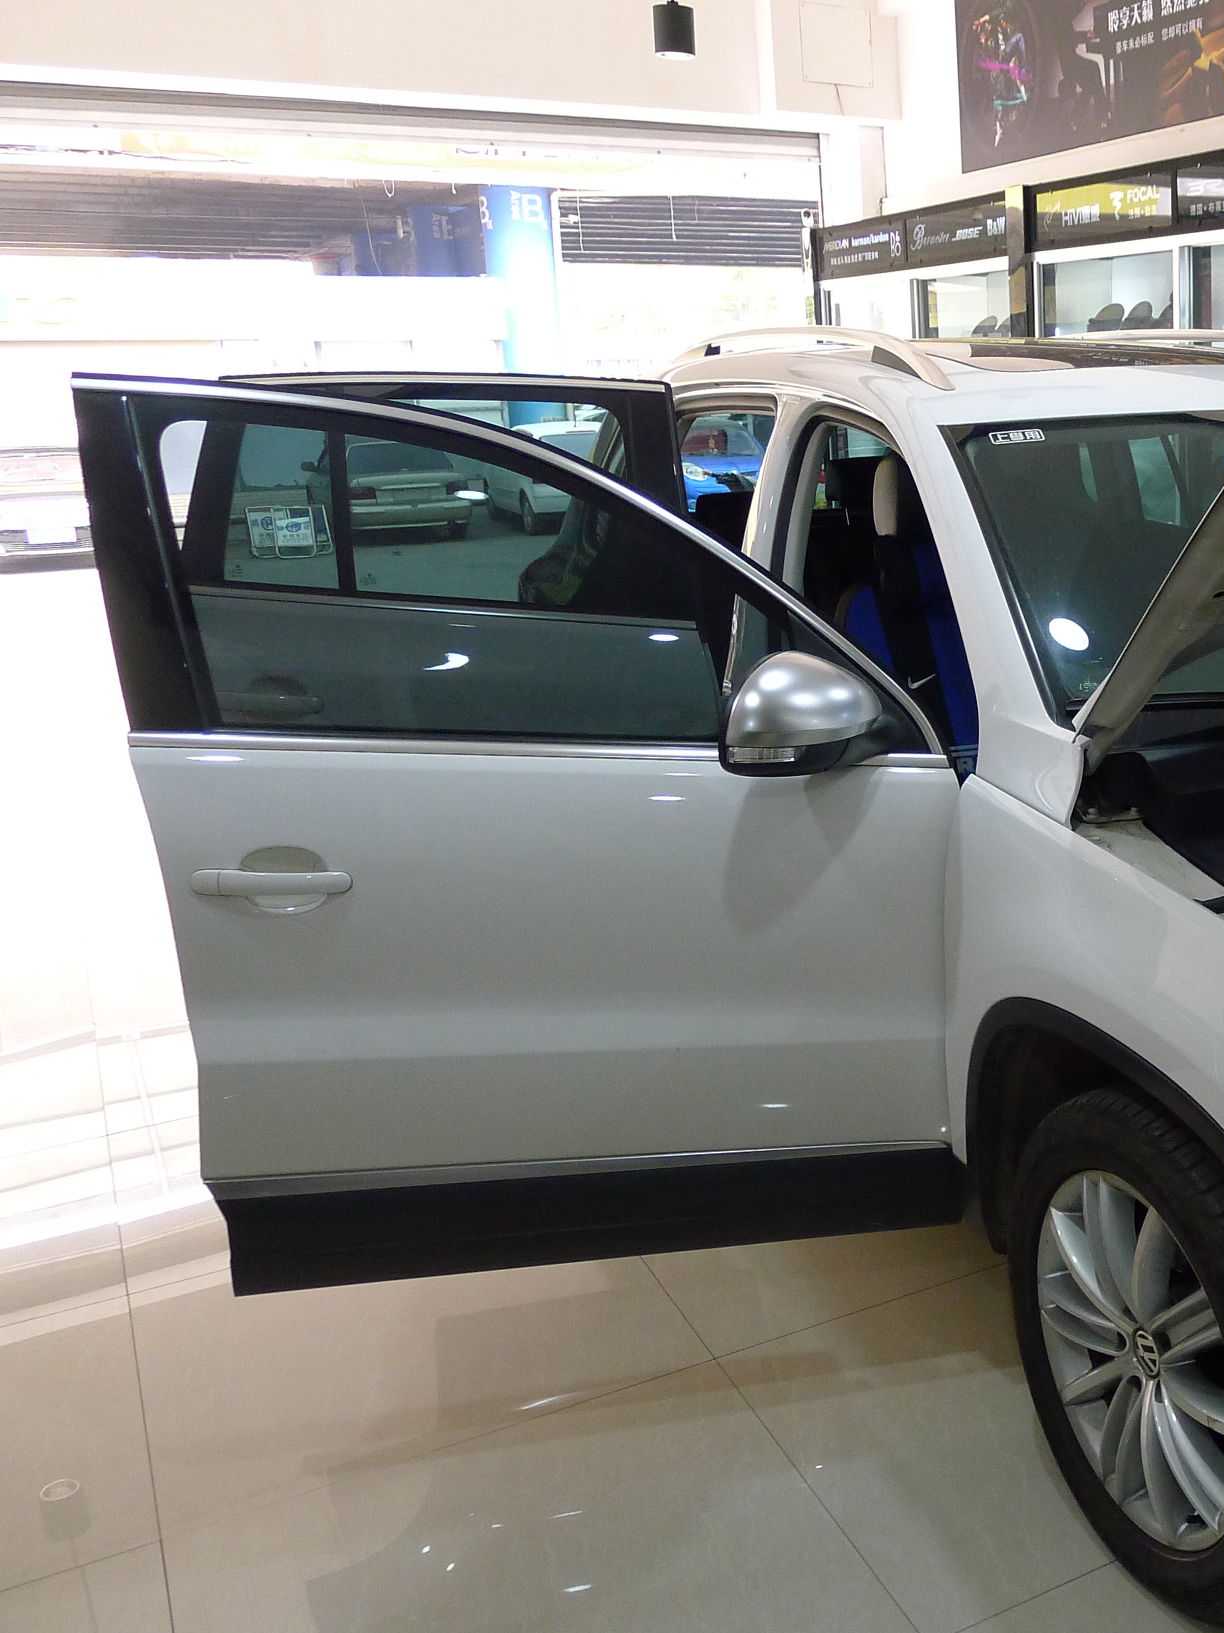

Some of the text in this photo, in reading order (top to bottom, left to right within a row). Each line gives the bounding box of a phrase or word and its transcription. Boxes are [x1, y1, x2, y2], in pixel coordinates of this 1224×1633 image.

[1161, 0, 1210, 17] 悠然
[1127, 185, 1160, 203] FOCAL
[952, 226, 983, 242] BOSE
